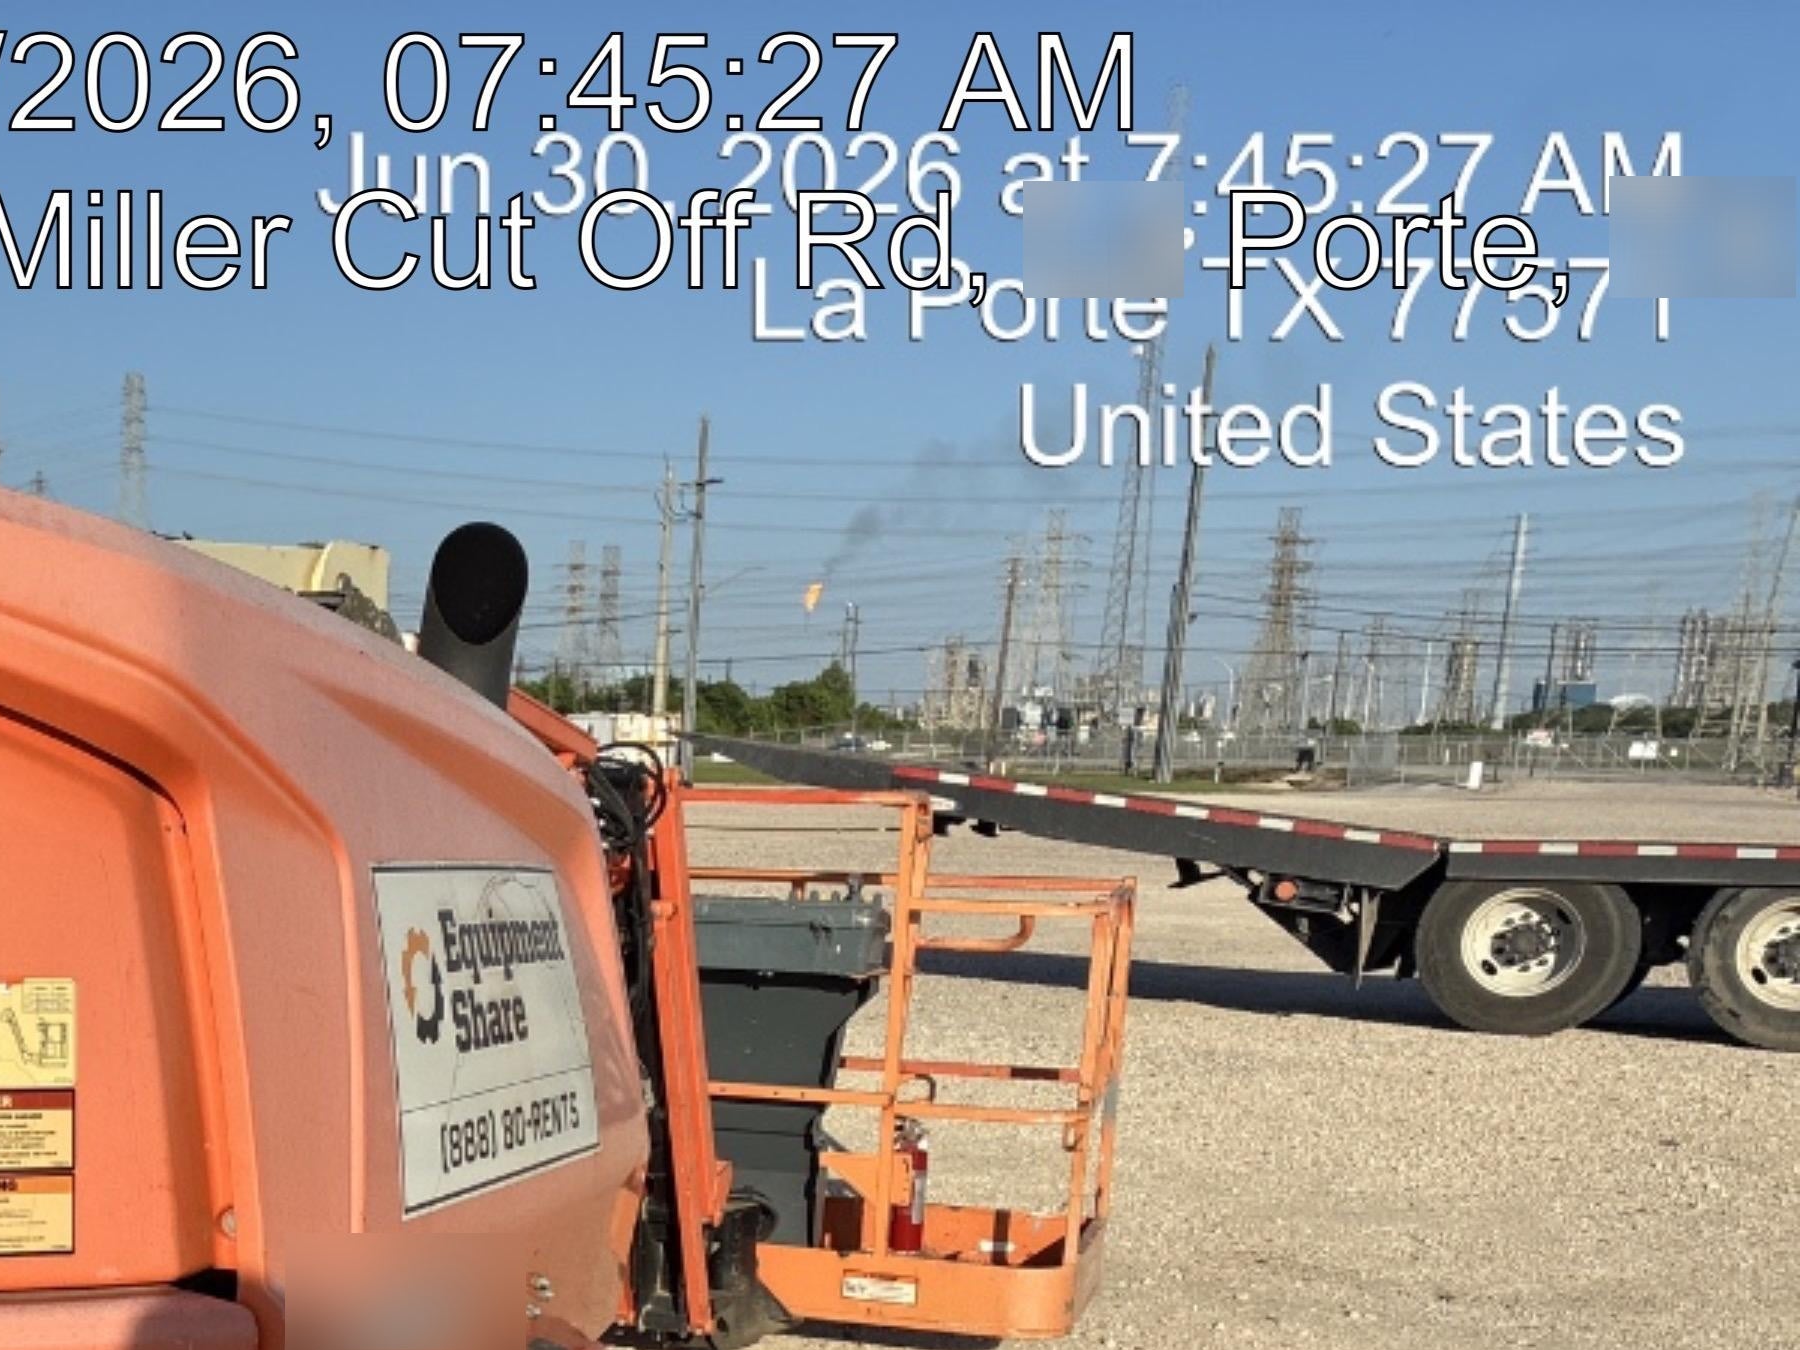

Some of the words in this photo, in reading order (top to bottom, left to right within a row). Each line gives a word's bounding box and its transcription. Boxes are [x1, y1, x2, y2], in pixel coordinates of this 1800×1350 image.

[437, 908, 565, 984] Equipment
[451, 989, 530, 1053] Share
[440, 1110, 497, 1173] (888)
[501, 1091, 580, 1151] 80-RENTS
